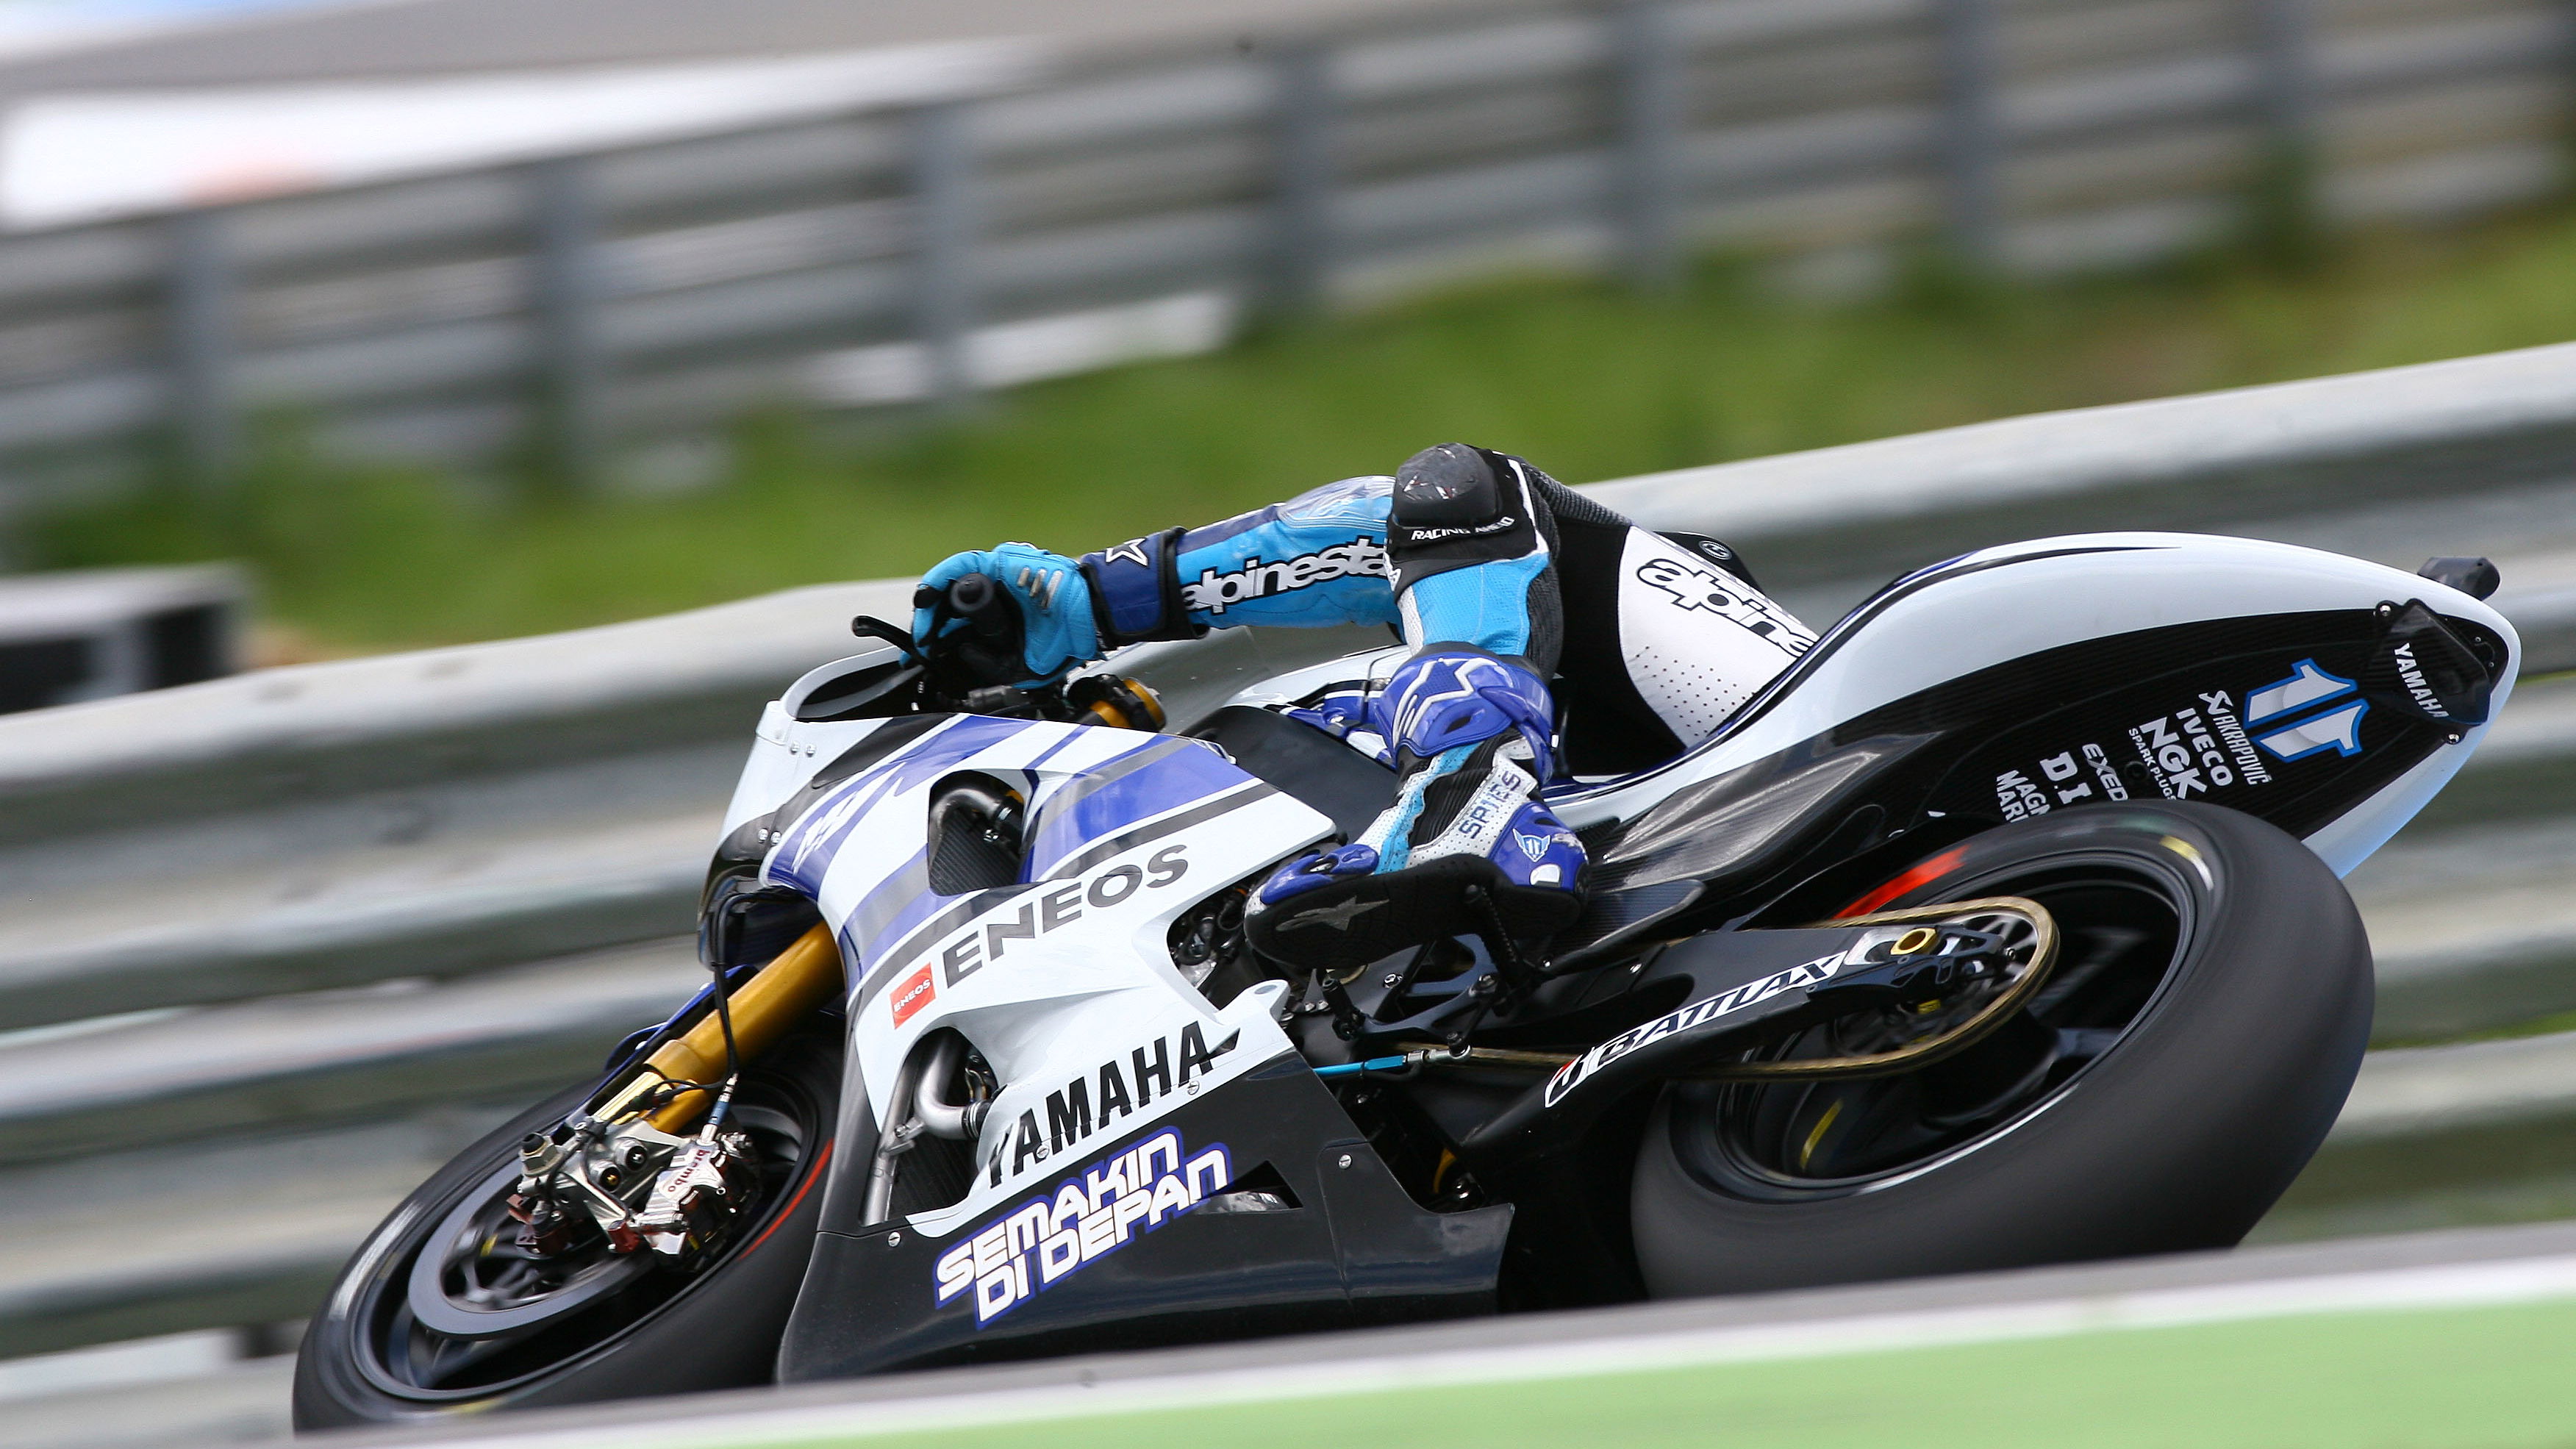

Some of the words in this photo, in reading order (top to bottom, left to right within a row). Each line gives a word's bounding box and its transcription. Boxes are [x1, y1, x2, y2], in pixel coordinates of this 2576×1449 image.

[2394, 643, 2450, 718] YAMAHA
[2128, 727, 2156, 767] SPARK
[2139, 716, 2208, 800] NGK
[2176, 707, 2233, 786] IVECO
[1458, 770, 1521, 840] SPIES
[942, 844, 1188, 989] ENEOS
[893, 978, 931, 1012] ENEOS
[1597, 956, 1840, 1069] BATTLAX
[987, 1020, 1214, 1189] YAMAHA
[936, 1131, 1180, 1302] SEMAKIN
[976, 1255, 1031, 1323] DI
[1042, 1148, 1230, 1285] DEPAN
